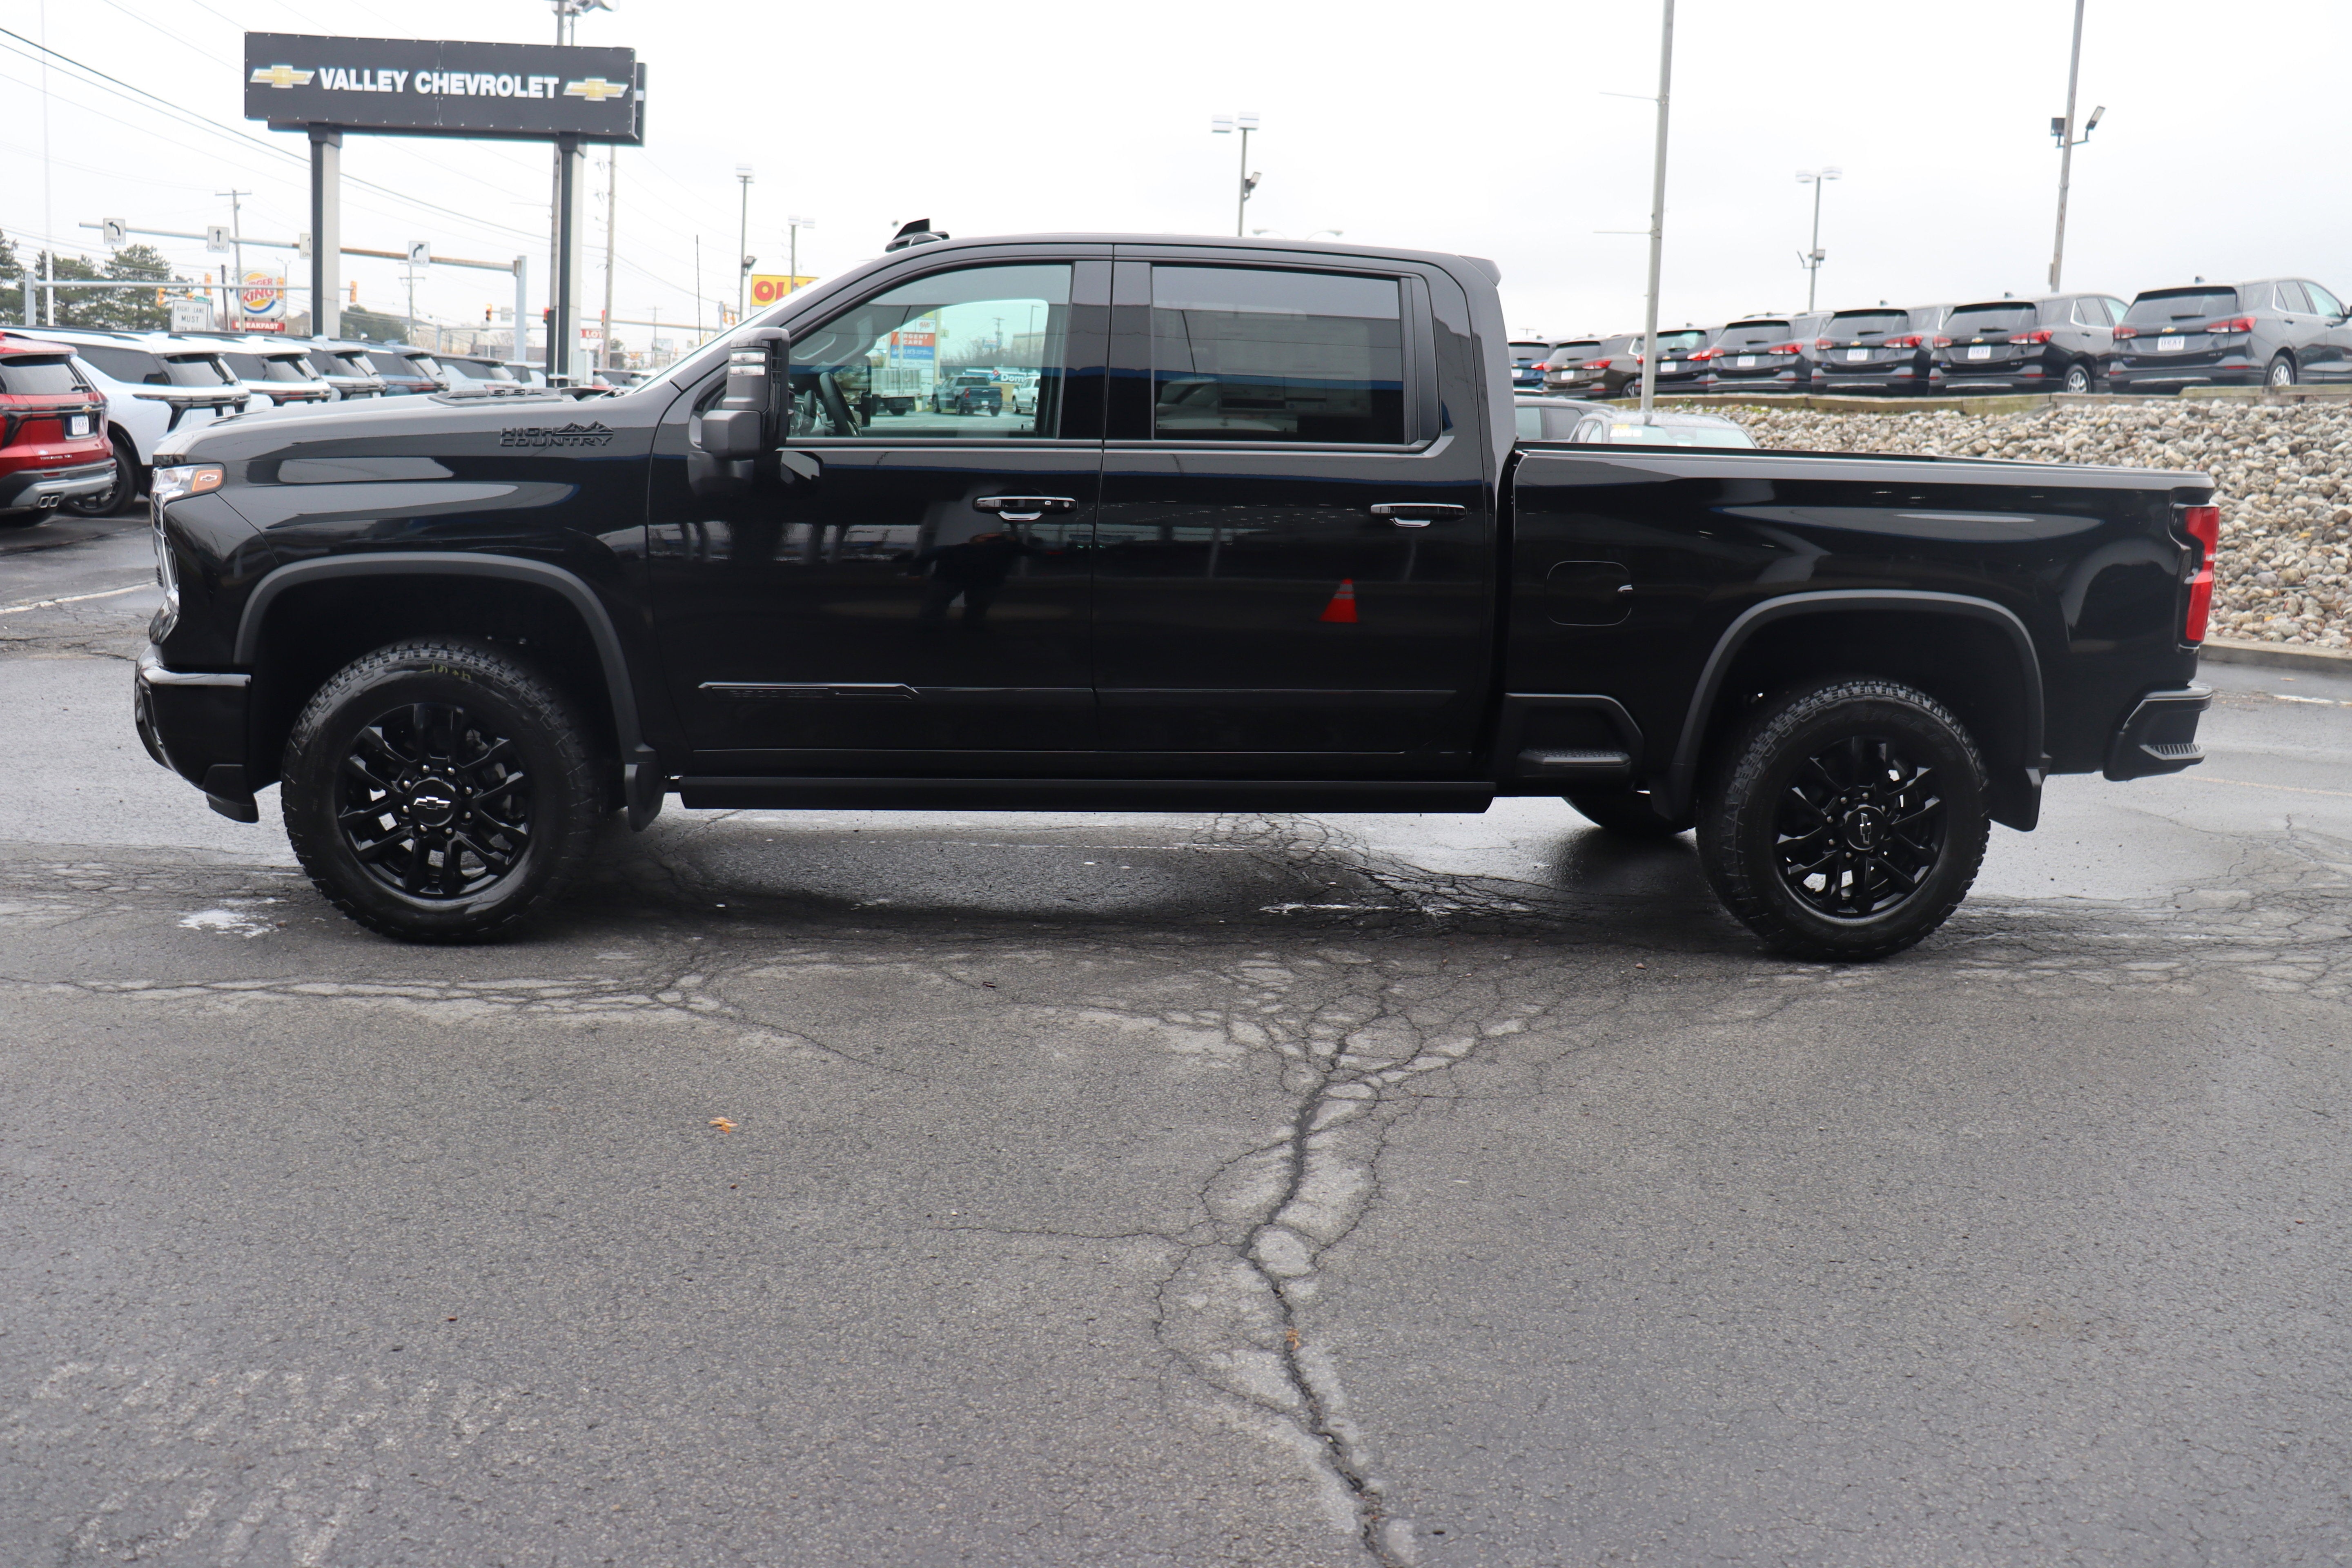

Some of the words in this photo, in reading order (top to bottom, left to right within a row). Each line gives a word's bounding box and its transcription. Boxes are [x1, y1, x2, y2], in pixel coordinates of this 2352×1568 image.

[319, 68, 409, 93] VALLEY
[414, 71, 559, 98] CHEVROLET
[243, 287, 274, 303] KING
[181, 315, 199, 323] MUST
[501, 428, 557, 437] HIGH
[1610, 429, 1642, 437] AWD
[500, 437, 613, 446] COUNTRY
